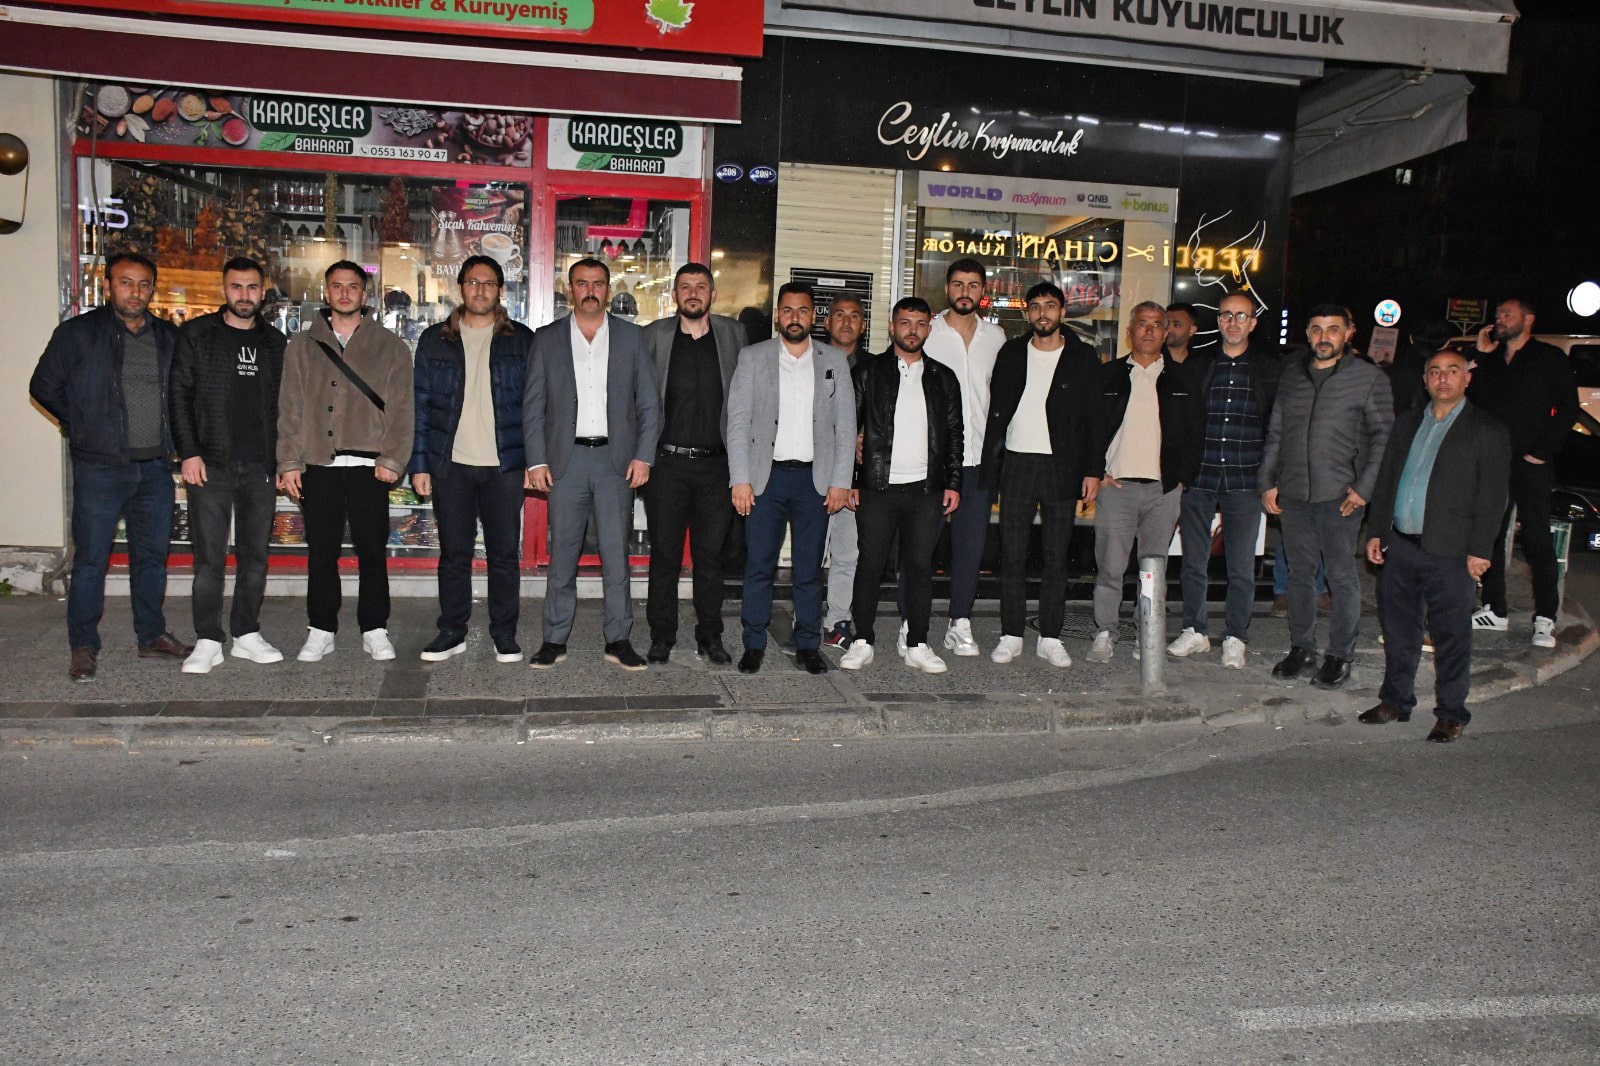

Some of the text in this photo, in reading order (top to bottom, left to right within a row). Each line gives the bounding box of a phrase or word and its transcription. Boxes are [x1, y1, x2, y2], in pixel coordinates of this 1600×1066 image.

[454, 0, 568, 25] Kuruyemiş
[1112, 0, 1345, 45] KUYUMCULUK
[253, 99, 365, 134] KARDEŞLER
[571, 121, 676, 153] KARDEŞLER
[877, 101, 1084, 161] Ceylin Kuyumculuk
[294, 137, 351, 154] BAHARAT
[370, 147, 446, 160] 0553 163 90 47
[610, 157, 663, 173] BAHARAT
[722, 167, 737, 177] 208
[927, 184, 1003, 201] WORLD
[1011, 192, 1067, 207] maximum
[1087, 194, 1109, 204] QNB
[1132, 198, 1169, 213] bonus
[466, 218, 517, 232] Kahvemize
